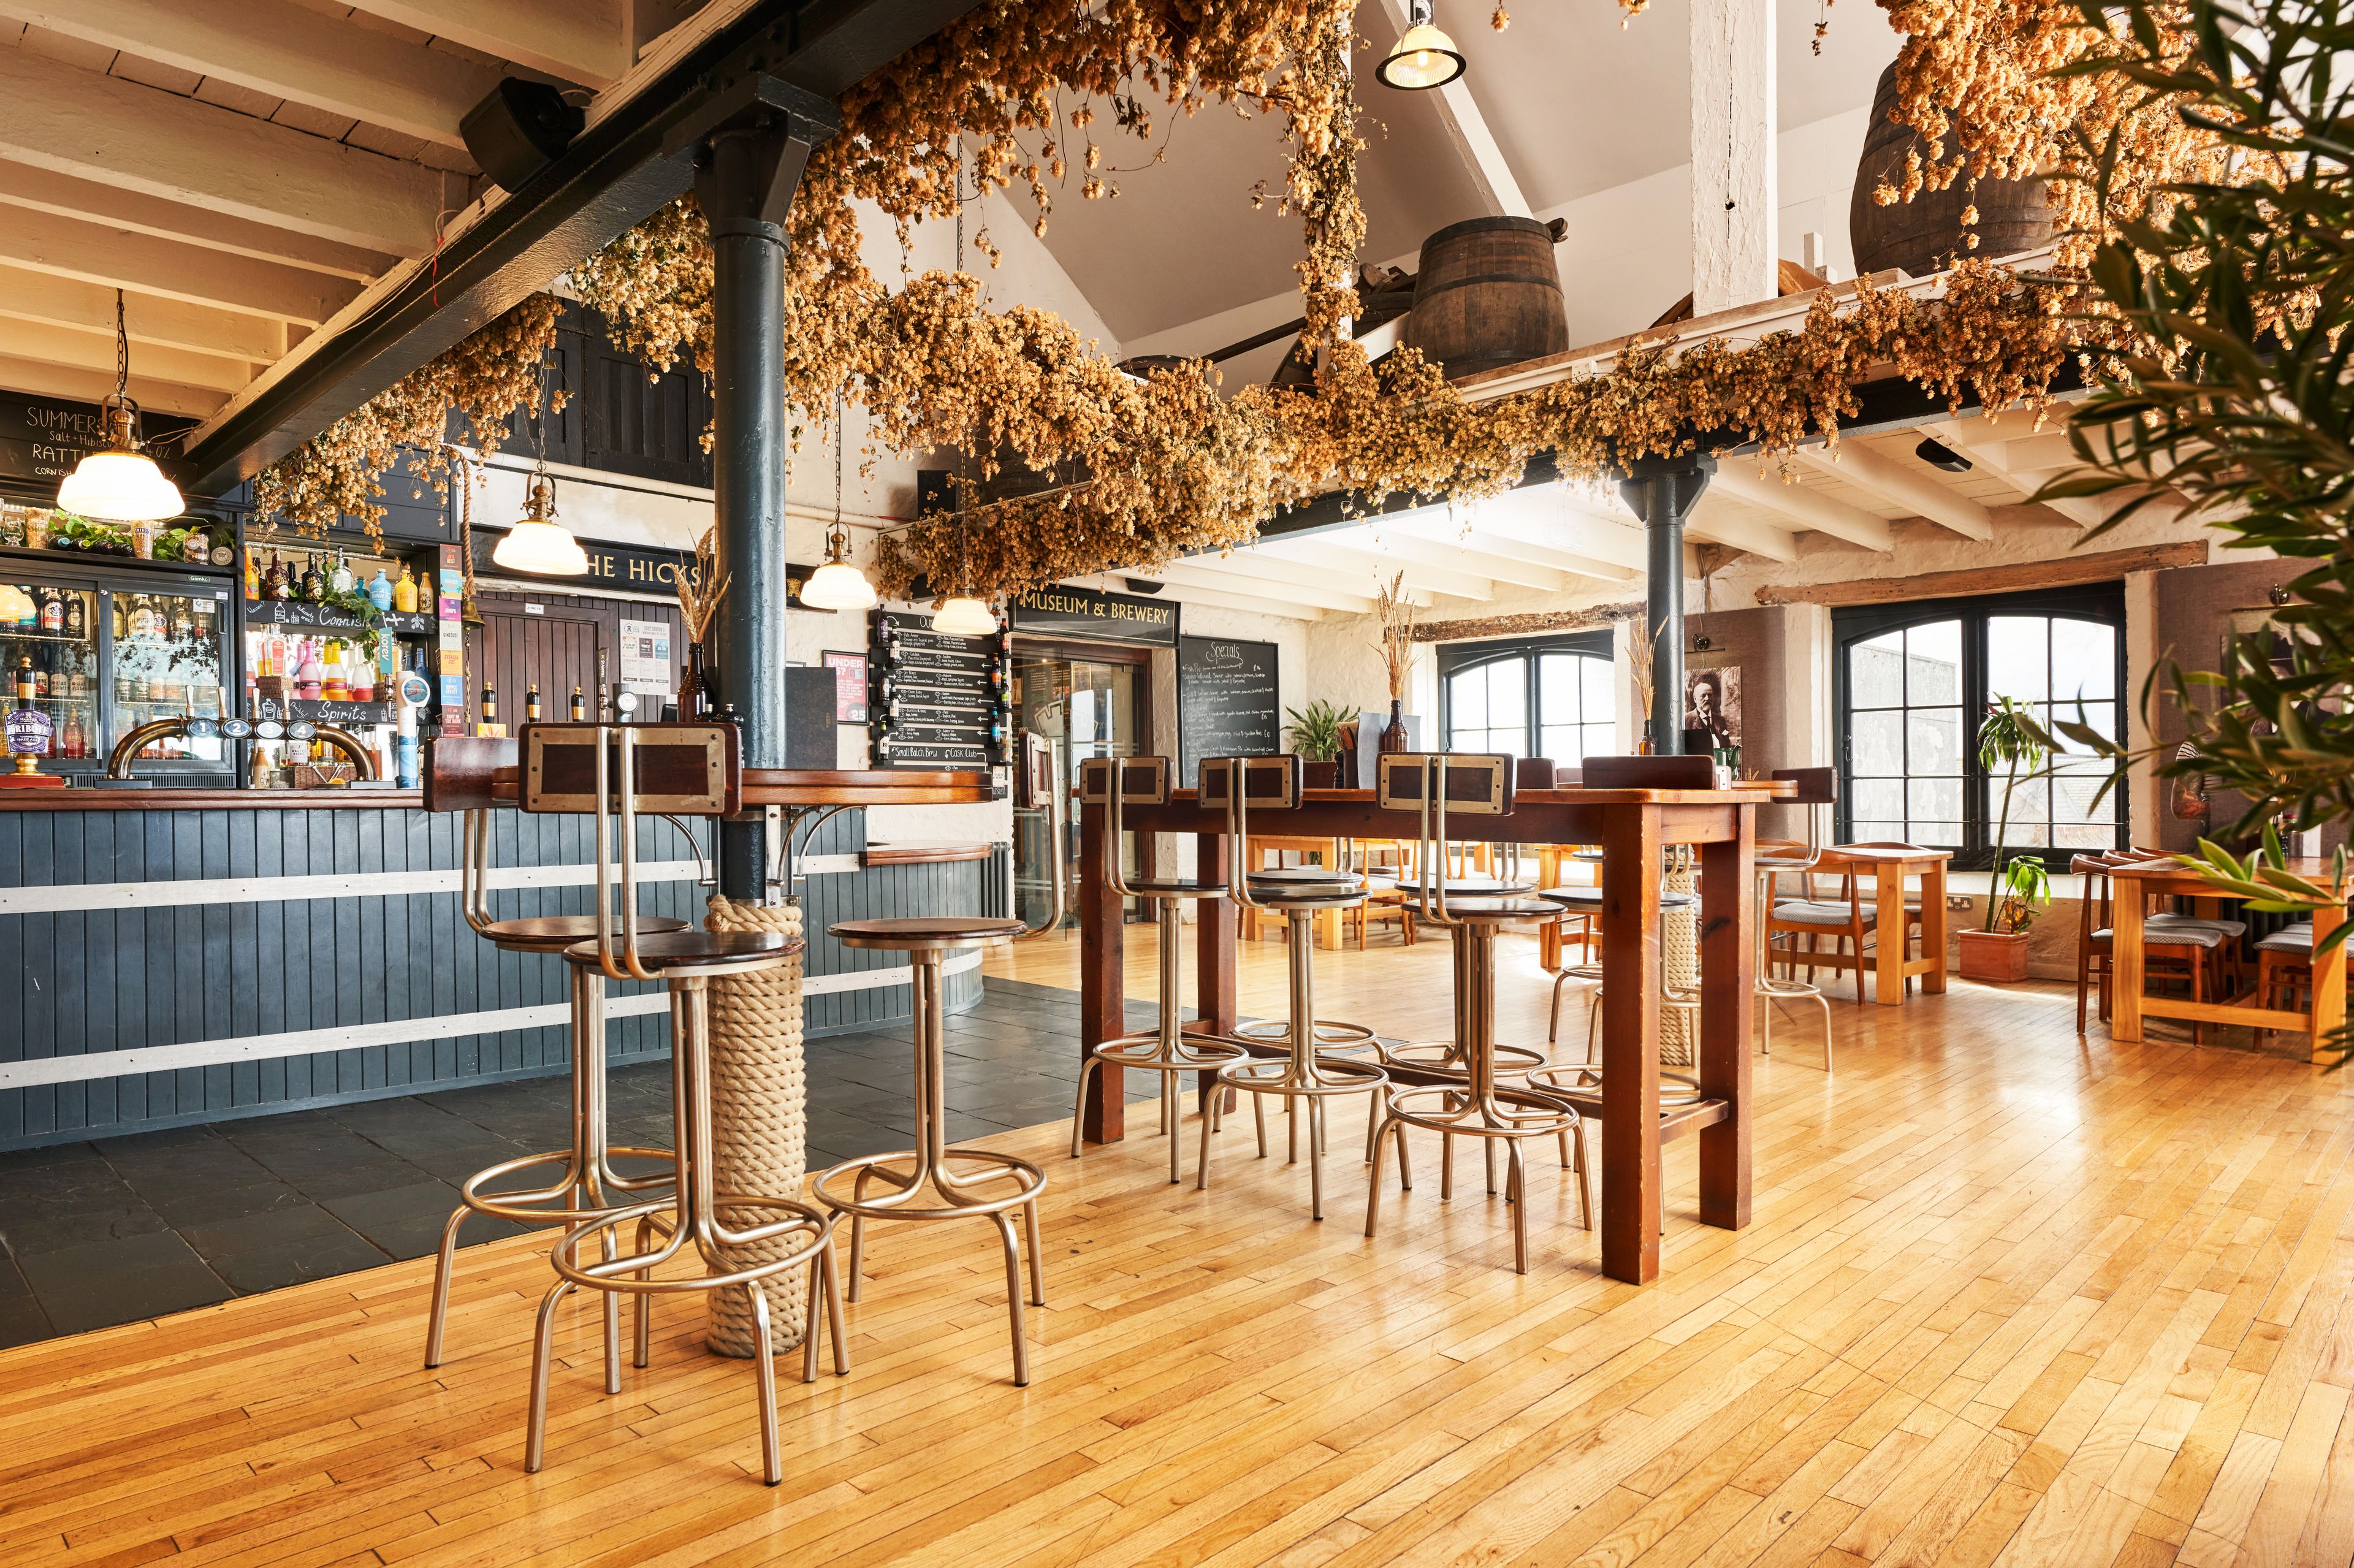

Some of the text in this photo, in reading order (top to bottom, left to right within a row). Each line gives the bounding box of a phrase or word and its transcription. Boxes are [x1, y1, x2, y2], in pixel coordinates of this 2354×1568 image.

[50, 431, 70, 443] Salt
[80, 436, 112, 448] Hibiscu
[32, 444, 101, 462] RATTL
[35, 467, 72, 477] CORNISH
[585, 554, 701, 587] HE HICKS
[1023, 593, 1169, 625] MUSEUM & BREWERY
[381, 634, 390, 661] korev
[1206, 642, 1242, 664] Specials
[828, 657, 863, 668] UNDER
[836, 667, 846, 676] 5?
[318, 701, 367, 722] Spirits
[851, 709, 866, 721] 25
[7, 723, 48, 735] TRIBUTE
[199, 723, 206, 733] 1
[232, 723, 242, 733] 2
[265, 725, 273, 734] 3
[297, 725, 307, 735] 4
[896, 747, 937, 758] Small Batch Brew
[950, 747, 977, 758] Cask Club
[992, 786, 1006, 795] ustell
